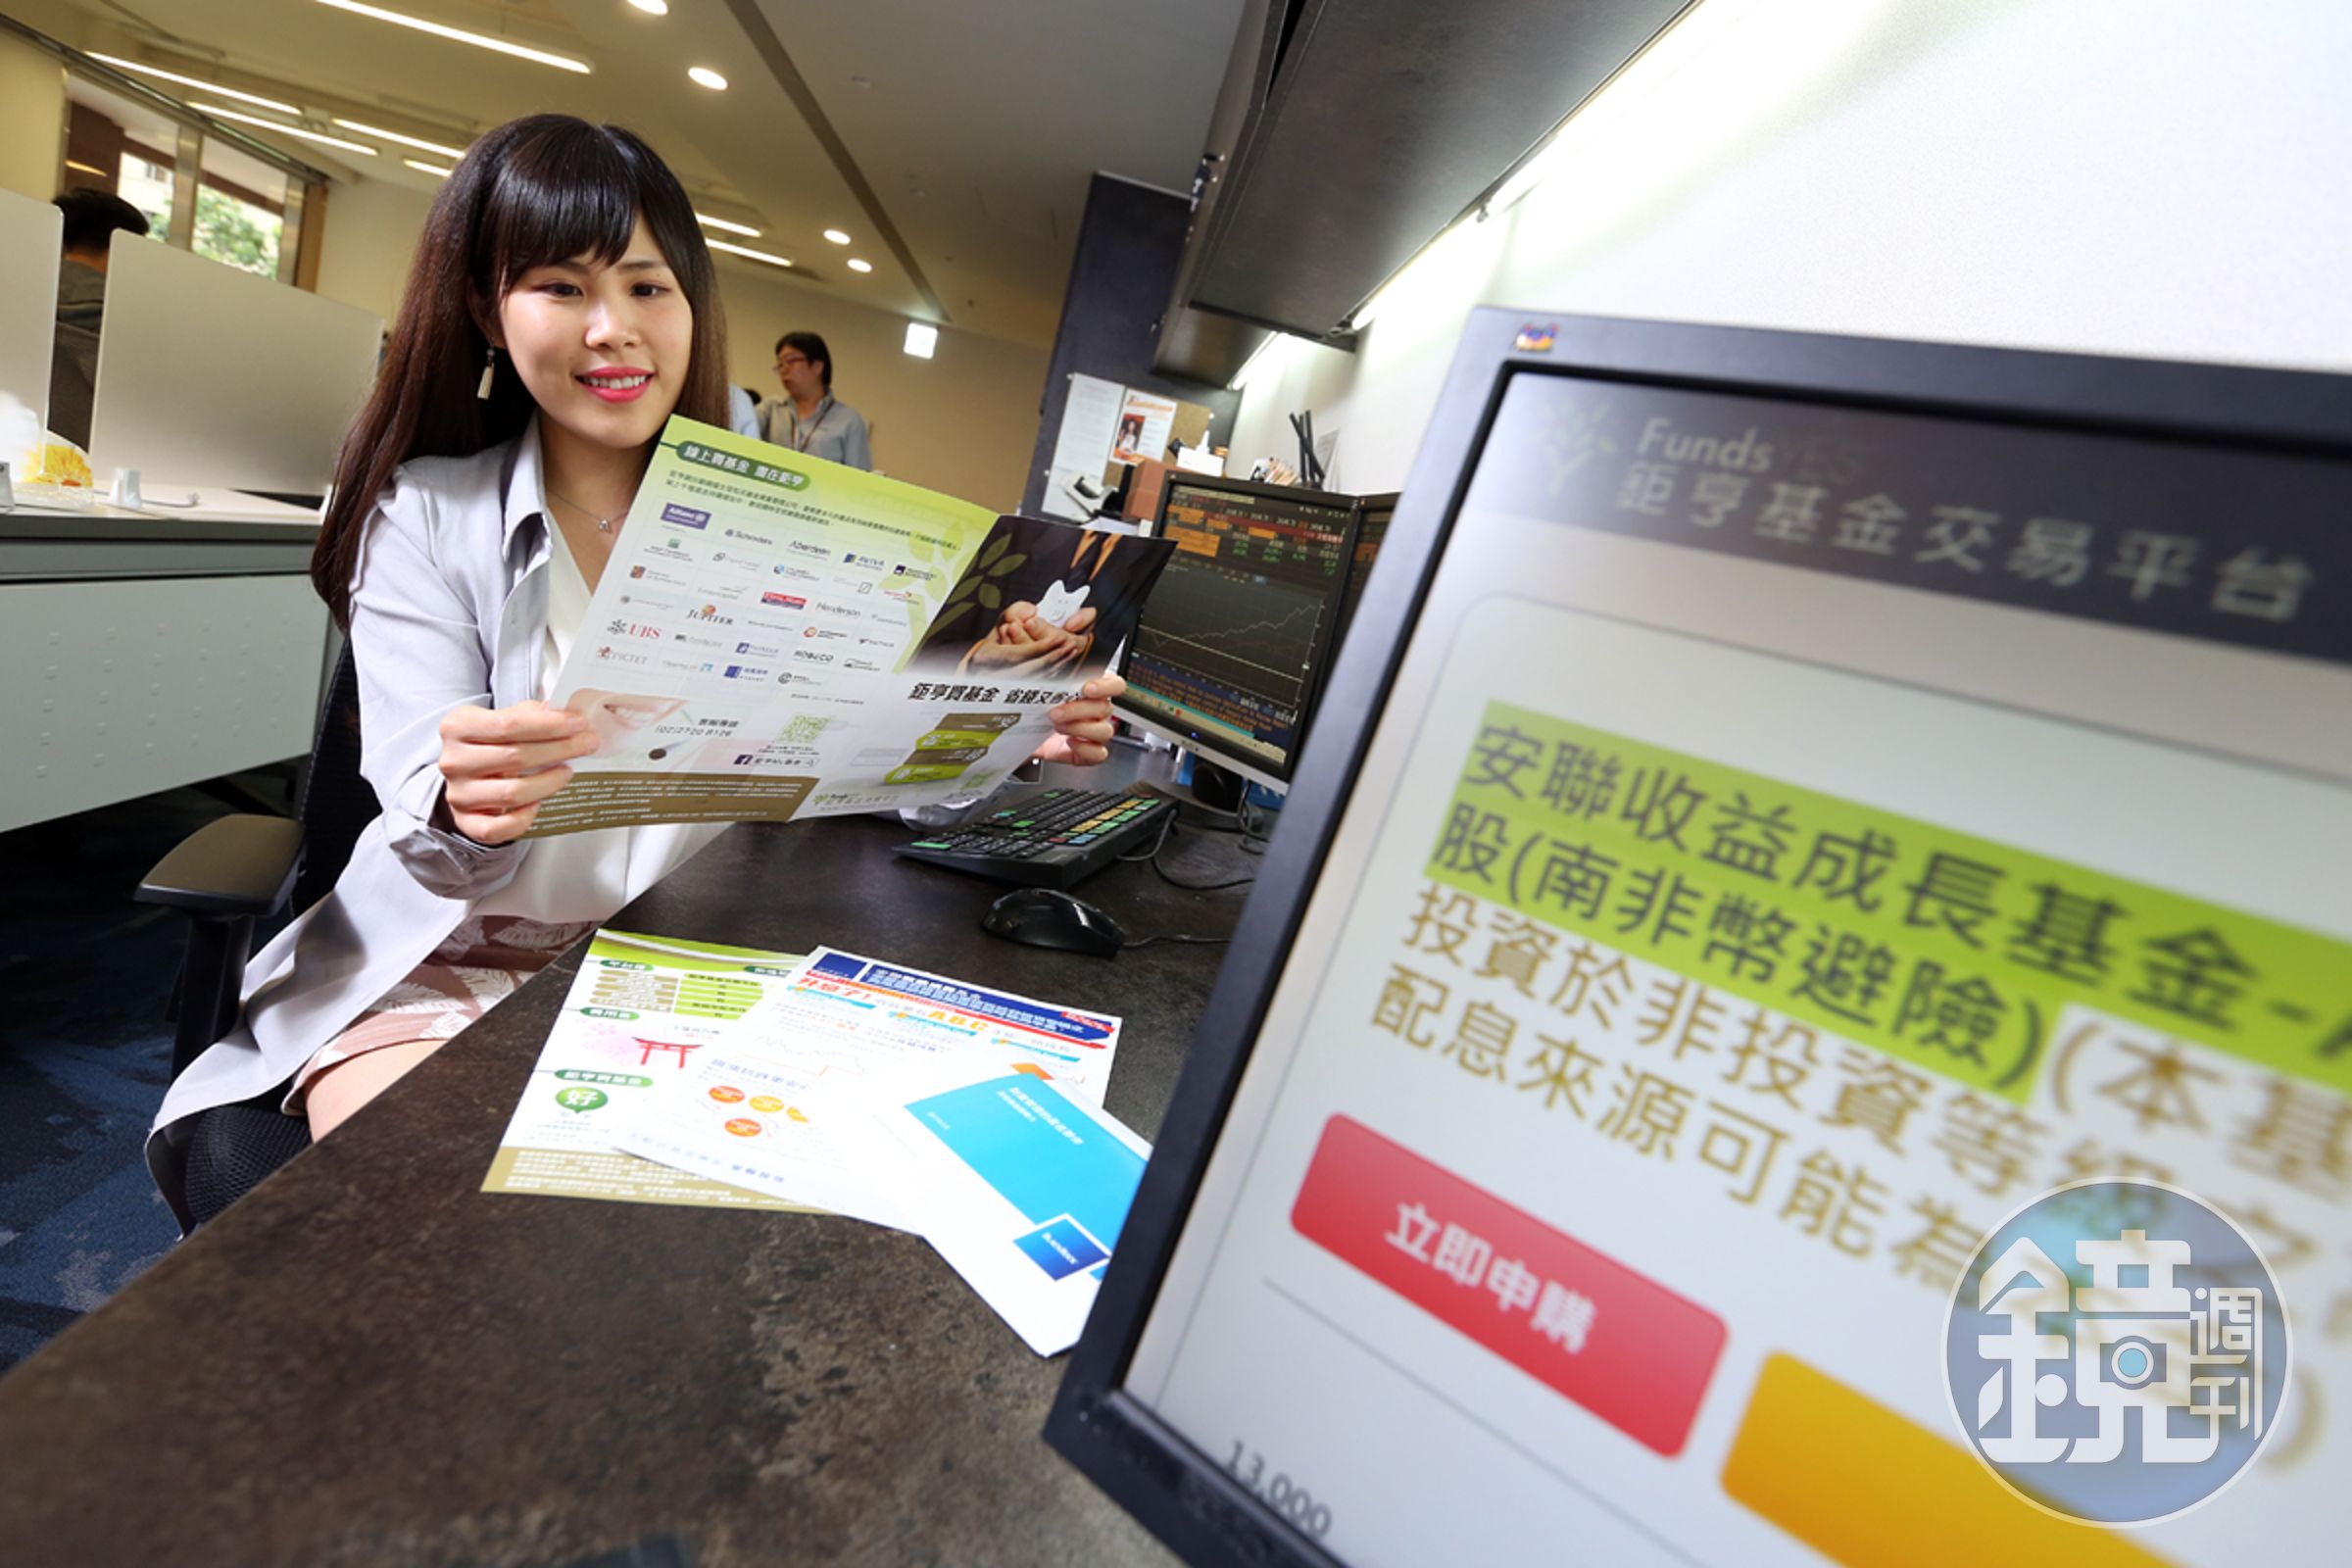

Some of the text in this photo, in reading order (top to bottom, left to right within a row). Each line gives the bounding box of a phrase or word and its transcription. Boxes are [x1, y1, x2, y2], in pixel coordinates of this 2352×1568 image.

[1617, 461, 2315, 623] 鉅亨基金交易平台
[686, 609, 734, 626] JUPITER
[628, 623, 662, 639] UBS
[907, 682, 1001, 703] 鉅亨買基金
[564, 1090, 600, 1107] 好
[1385, 1200, 1599, 1356] 立即申購
